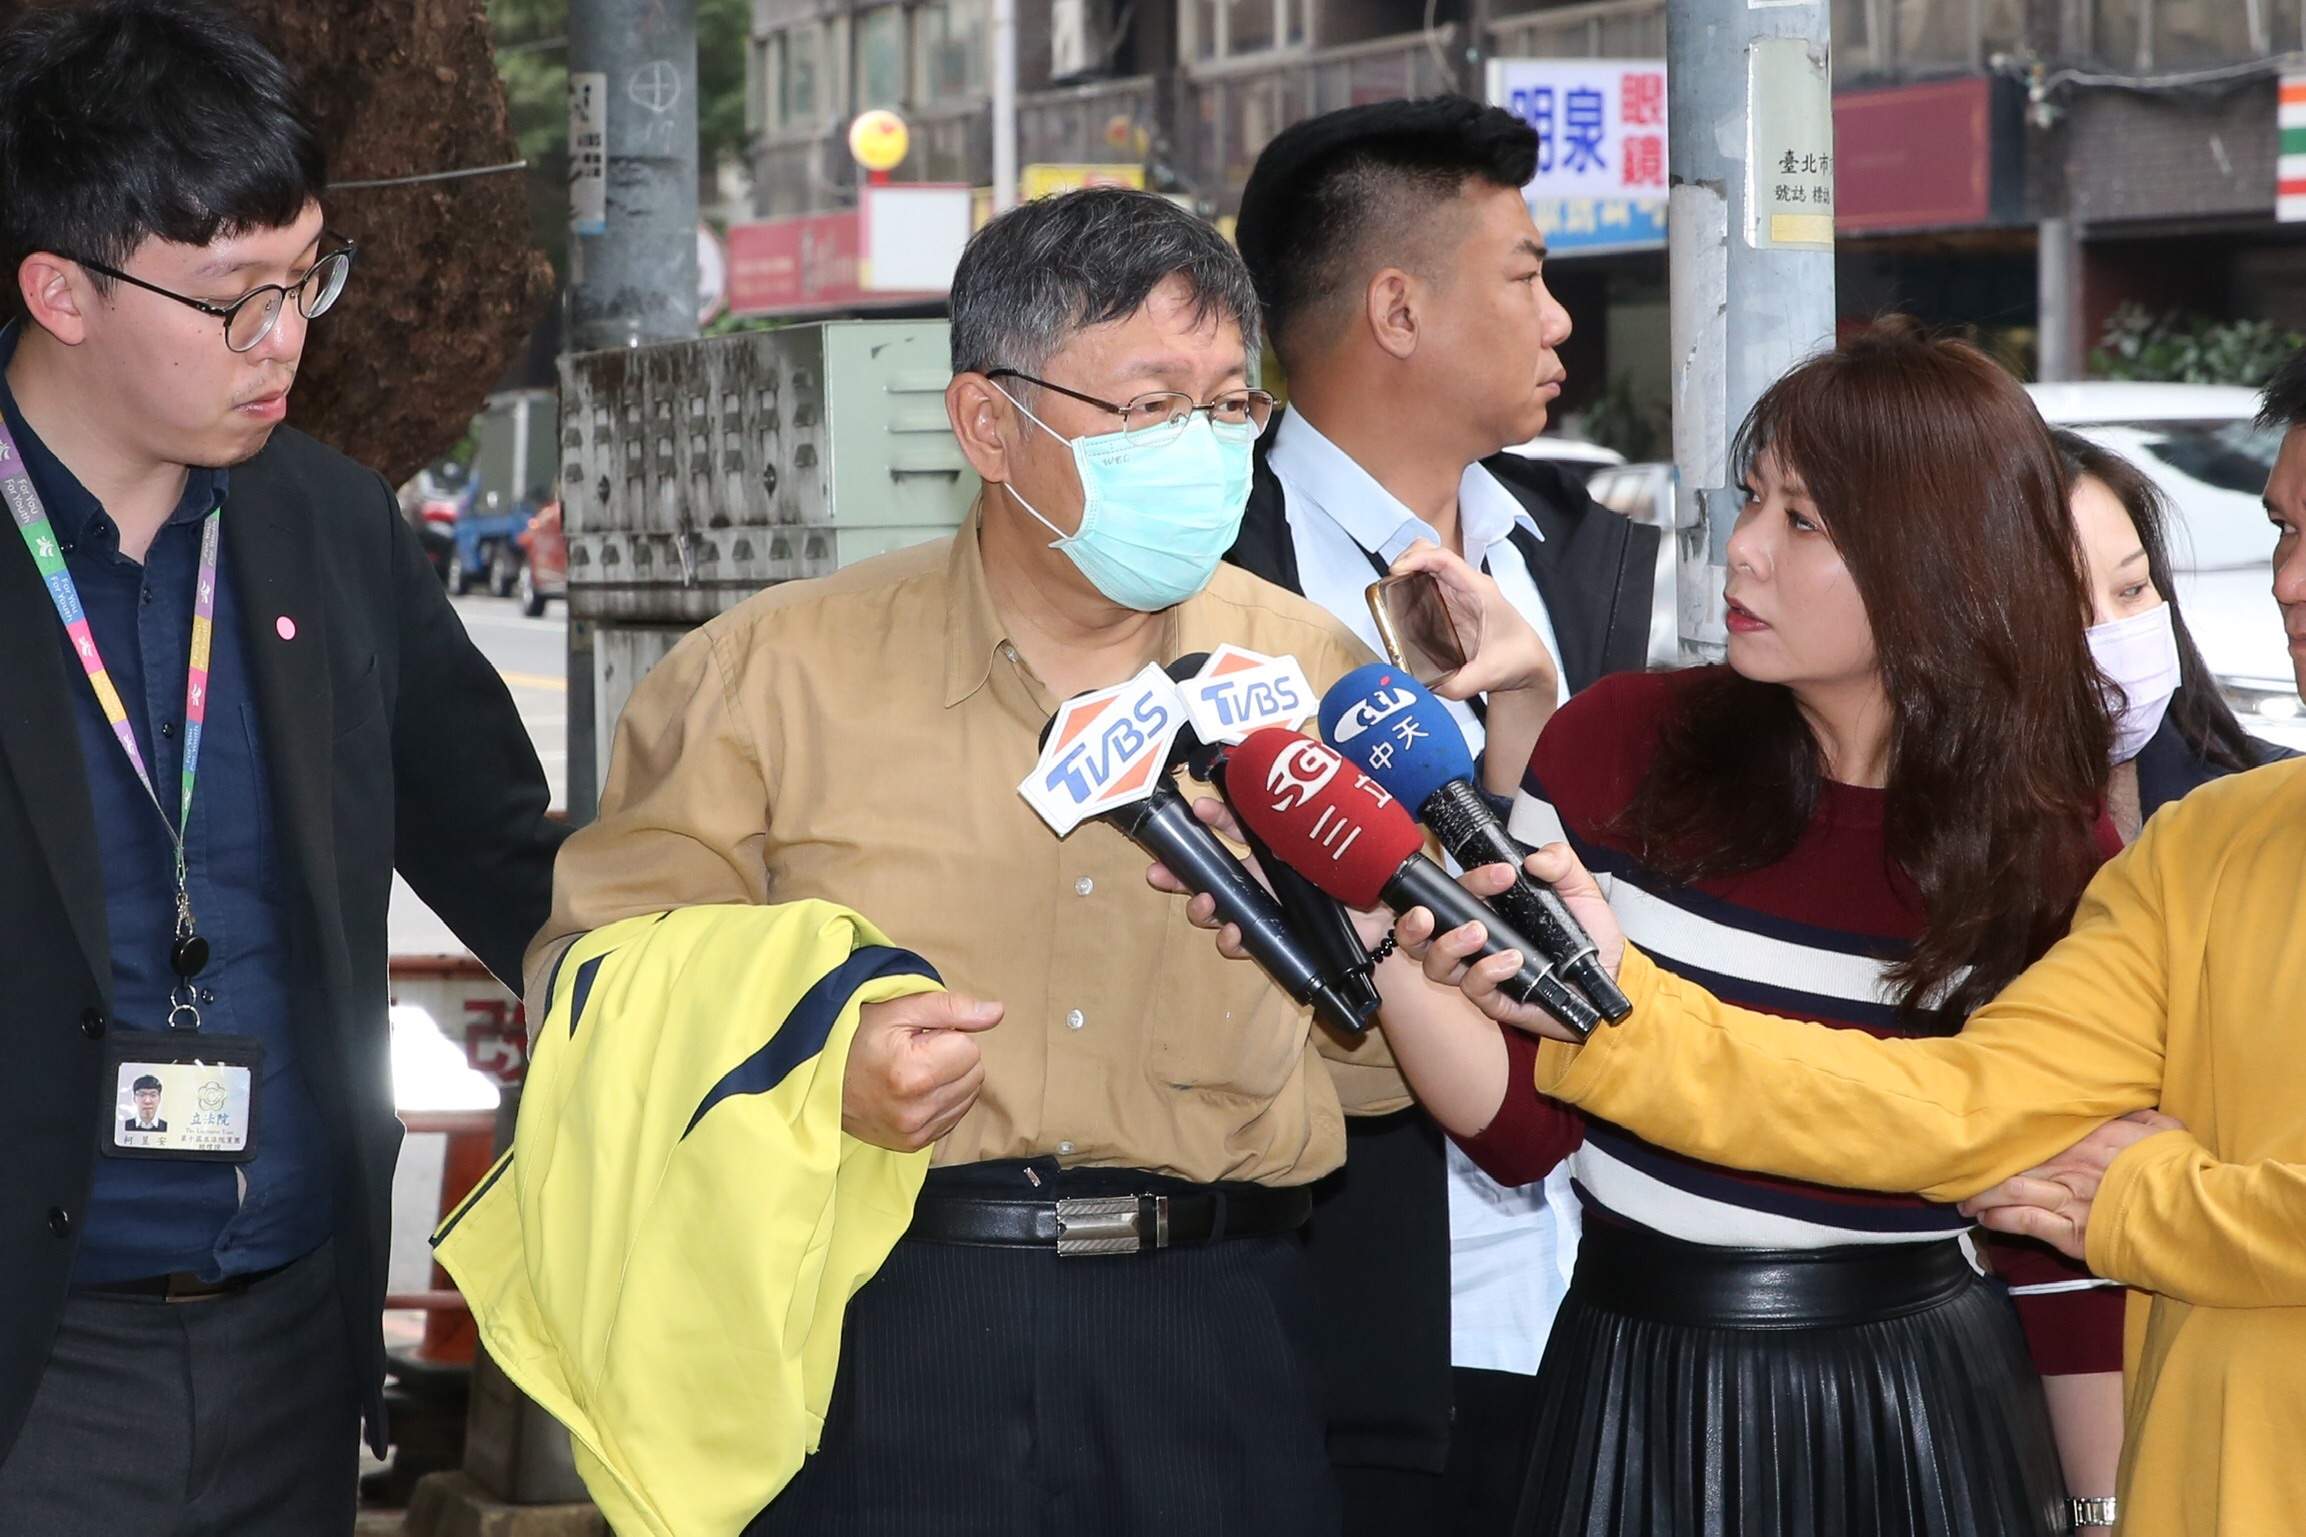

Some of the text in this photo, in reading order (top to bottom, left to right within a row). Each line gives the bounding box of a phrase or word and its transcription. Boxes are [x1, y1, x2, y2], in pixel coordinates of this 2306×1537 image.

[1779, 149, 1833, 176] 臺北市
[15, 493, 31, 523] Youth
[26, 490, 39, 515] You
[58, 592, 73, 623] Youth
[68, 591, 79, 614] You
[1201, 676, 1299, 726] TVBS
[1046, 690, 1168, 804] TVBS
[1369, 715, 1429, 770] 中天
[190, 1112, 230, 1126] 立法院
